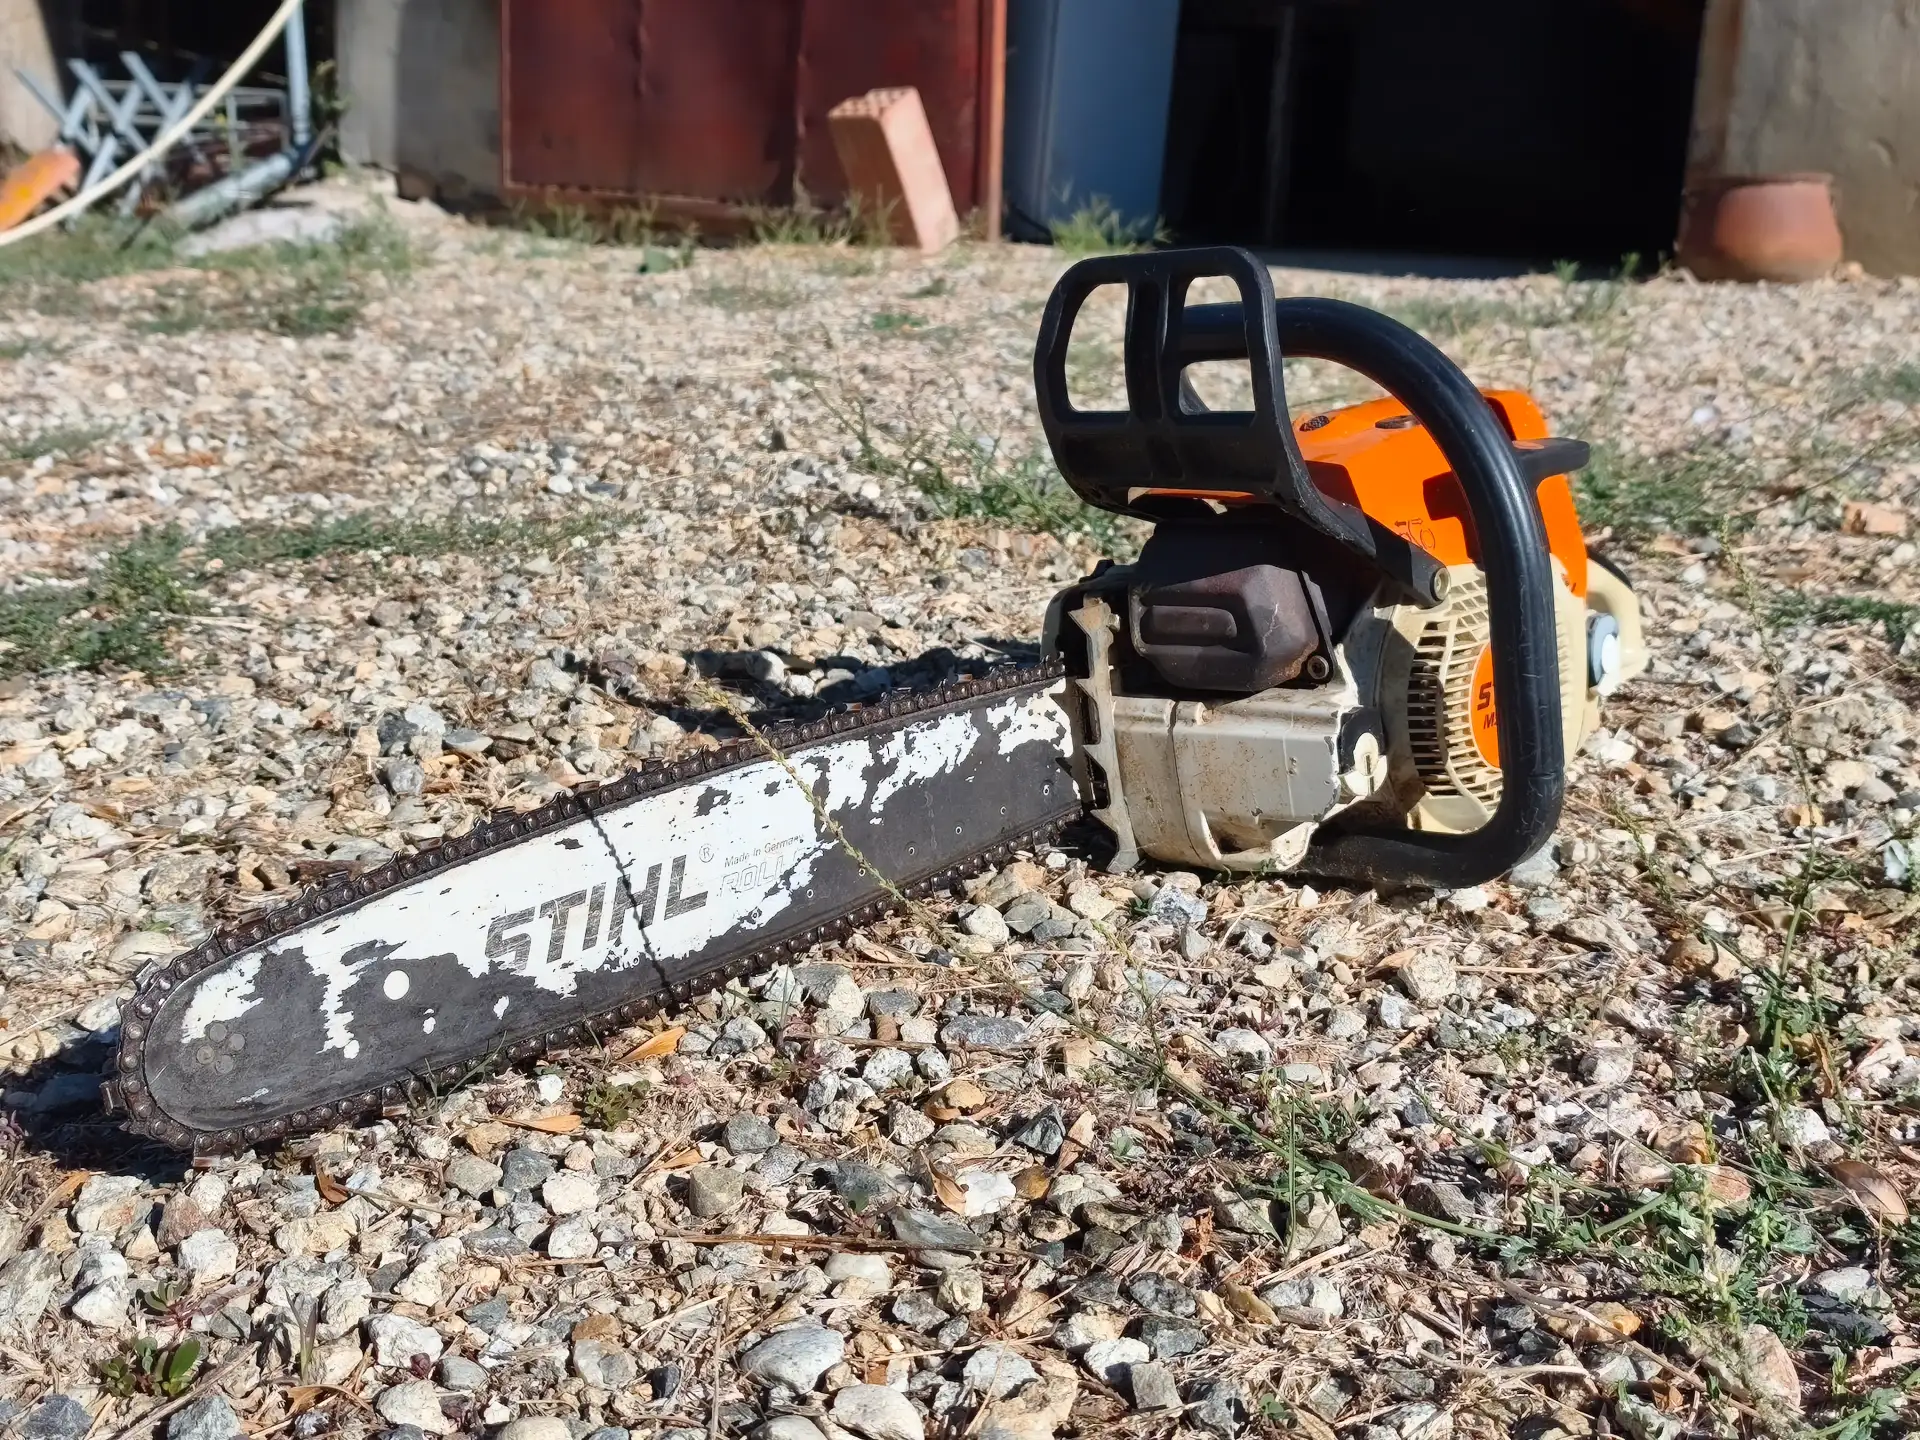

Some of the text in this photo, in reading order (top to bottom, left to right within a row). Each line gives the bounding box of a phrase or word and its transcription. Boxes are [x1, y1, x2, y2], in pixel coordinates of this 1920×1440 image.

[723, 850, 750, 868] Made
[752, 846, 762, 858] in
[485, 854, 709, 973] STIHL
